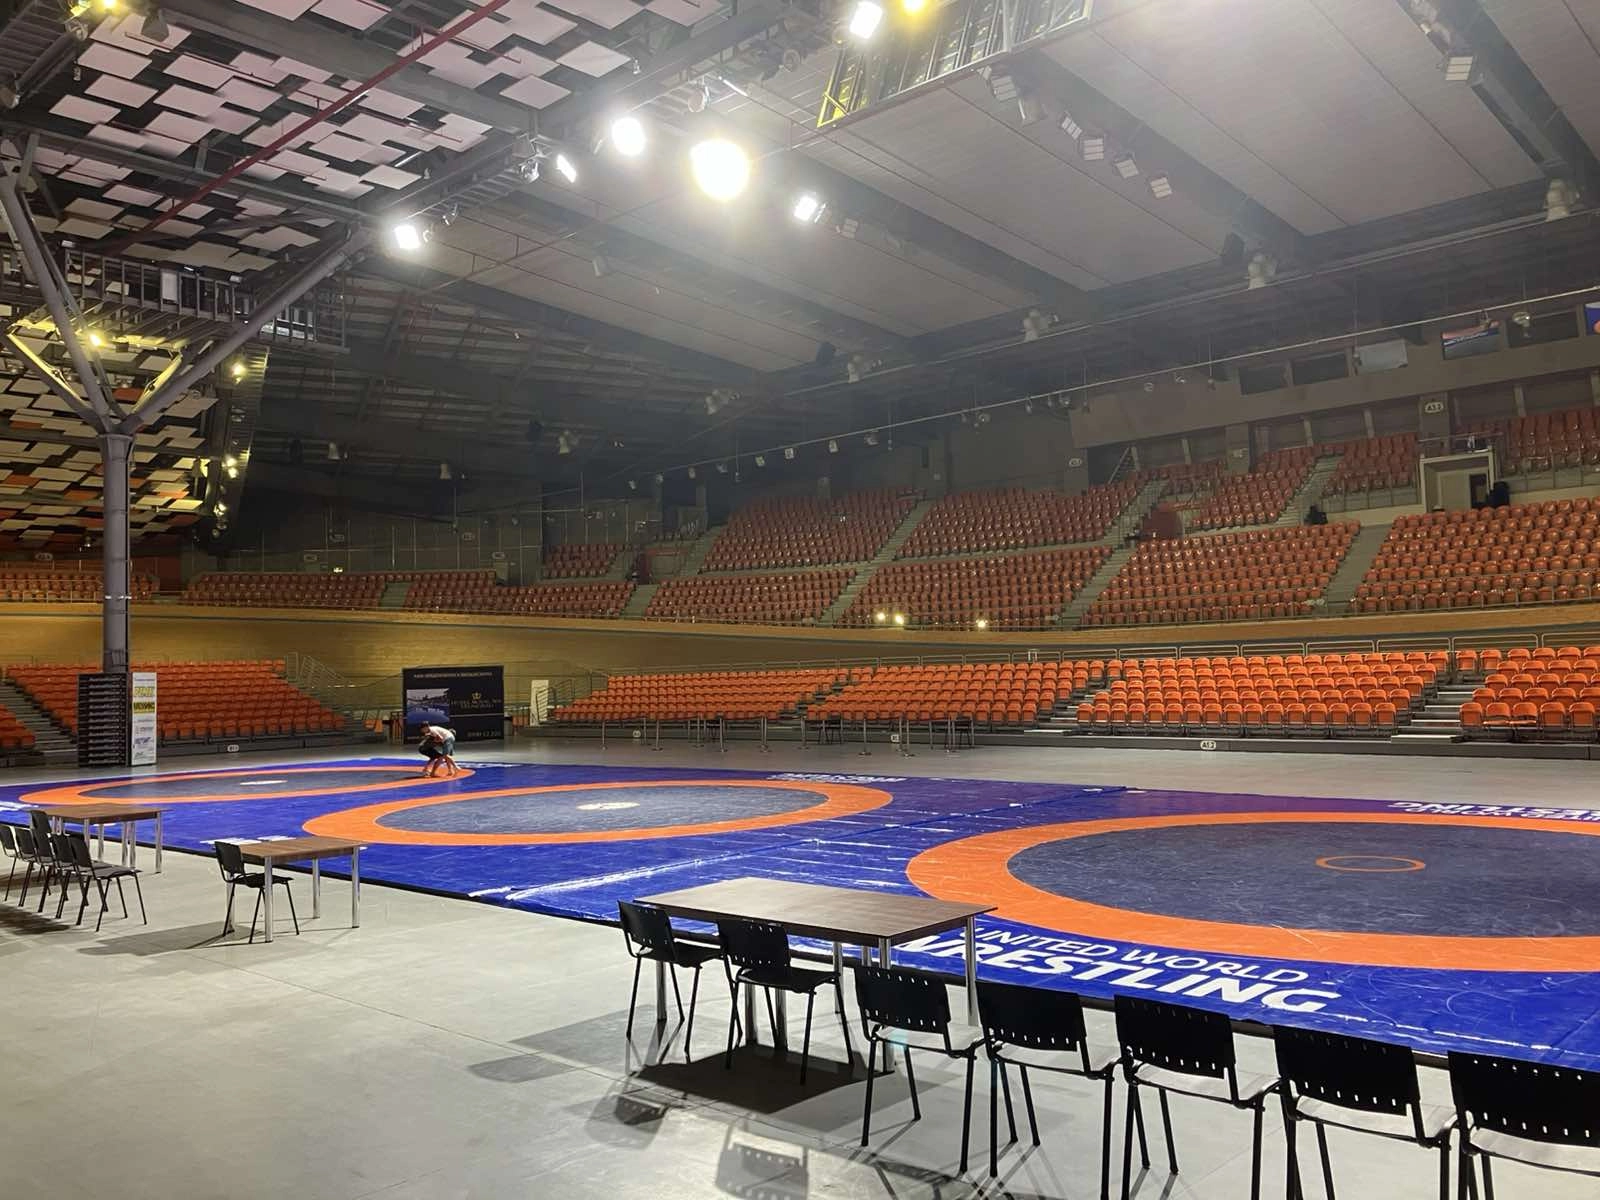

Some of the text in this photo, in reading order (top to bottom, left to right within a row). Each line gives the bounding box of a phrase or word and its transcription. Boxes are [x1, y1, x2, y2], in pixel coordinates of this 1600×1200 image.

[893, 935, 1342, 1012] WRESTLING
[960, 927, 1310, 983] UNITED WORLD
